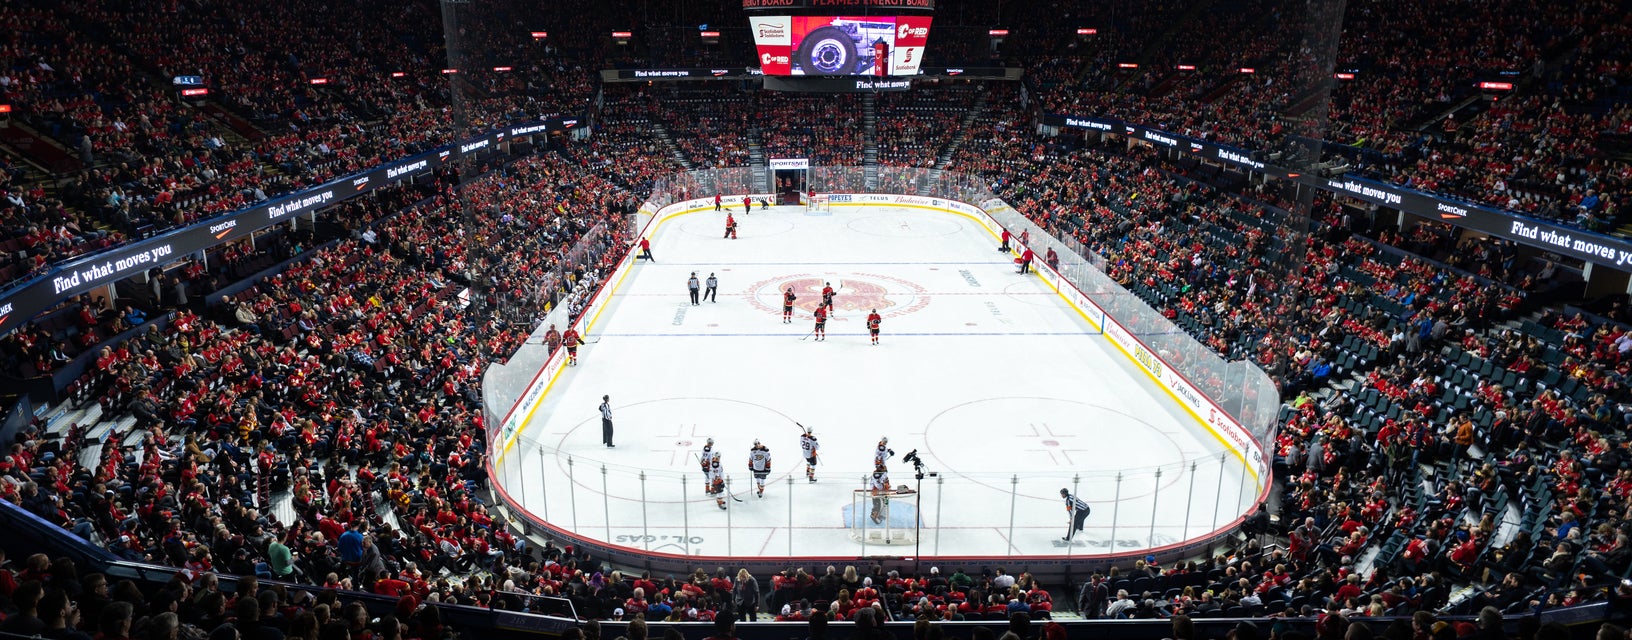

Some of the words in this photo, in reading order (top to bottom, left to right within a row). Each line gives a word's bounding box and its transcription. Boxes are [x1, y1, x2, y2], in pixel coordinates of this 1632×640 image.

[1218, 149, 1228, 159] Find
[1229, 152, 1240, 162] what
[387, 168, 398, 178] Find
[398, 165, 408, 174] what
[1344, 181, 1362, 193] what
[1362, 187, 1386, 200] moves
[1386, 192, 1401, 203] you
[268, 202, 285, 218] Find
[285, 199, 302, 212] what
[302, 194, 322, 207] moves
[321, 191, 333, 203] you
[1438, 203, 1467, 216] SPORTCHEK
[210, 220, 237, 233] SPORTCHEK
[1511, 221, 1538, 239] Find
[1540, 230, 1571, 248] what
[1573, 240, 1616, 259] moves
[53, 270, 80, 295] Find
[82, 261, 114, 282] what
[116, 250, 151, 272] moves
[152, 244, 172, 262] you
[1217, 417, 1247, 450] Scotiaban
[802, 441, 810, 450] 29
